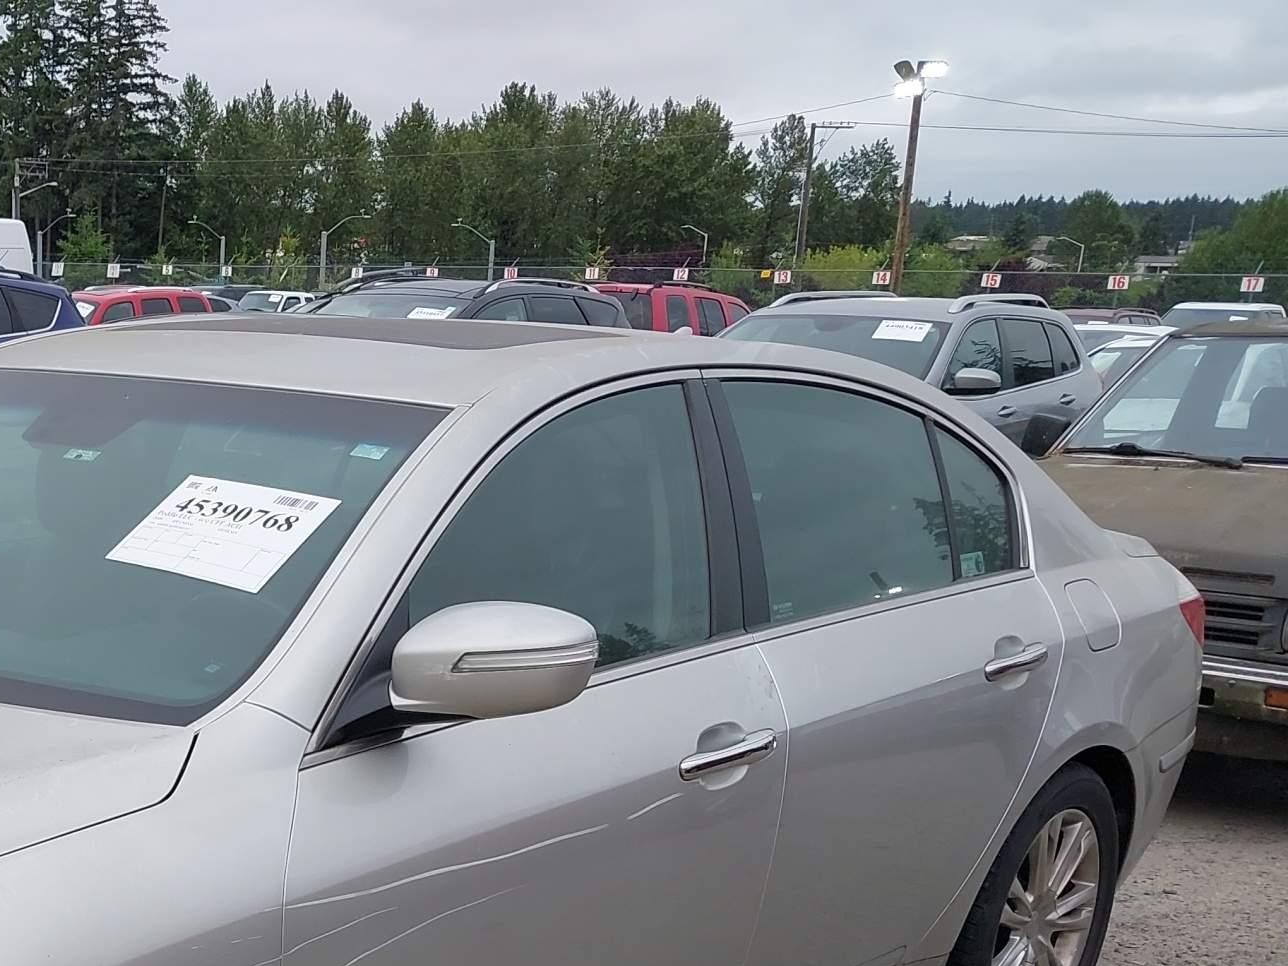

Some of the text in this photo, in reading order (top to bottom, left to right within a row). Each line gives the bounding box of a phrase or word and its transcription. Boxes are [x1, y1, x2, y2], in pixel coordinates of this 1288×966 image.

[676, 269, 687, 280] 12
[776, 271, 789, 283] 13
[876, 272, 888, 284] 14
[985, 274, 998, 287] 15
[1111, 276, 1126, 289] 16
[1245, 278, 1260, 291] 17
[175, 497, 300, 532] 45390768
